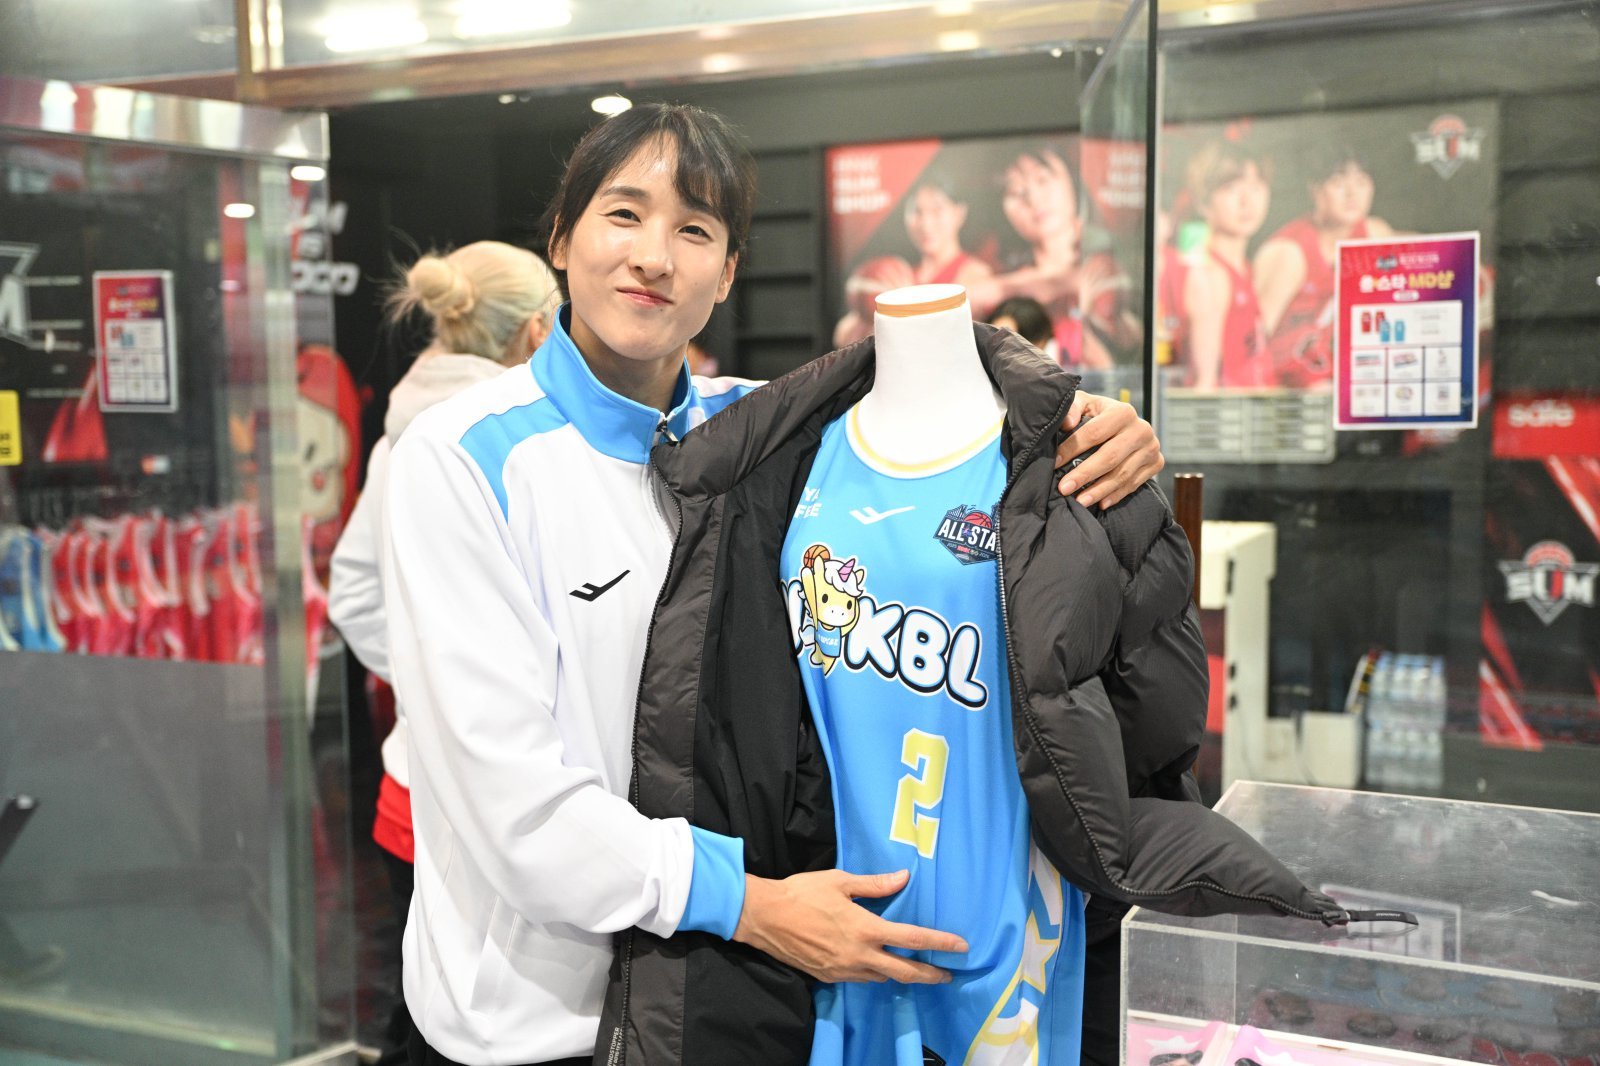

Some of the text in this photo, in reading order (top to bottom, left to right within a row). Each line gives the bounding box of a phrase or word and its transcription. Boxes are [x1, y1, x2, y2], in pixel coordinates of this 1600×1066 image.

[938, 519, 997, 552] ALL STA
[889, 727, 950, 860] 2
